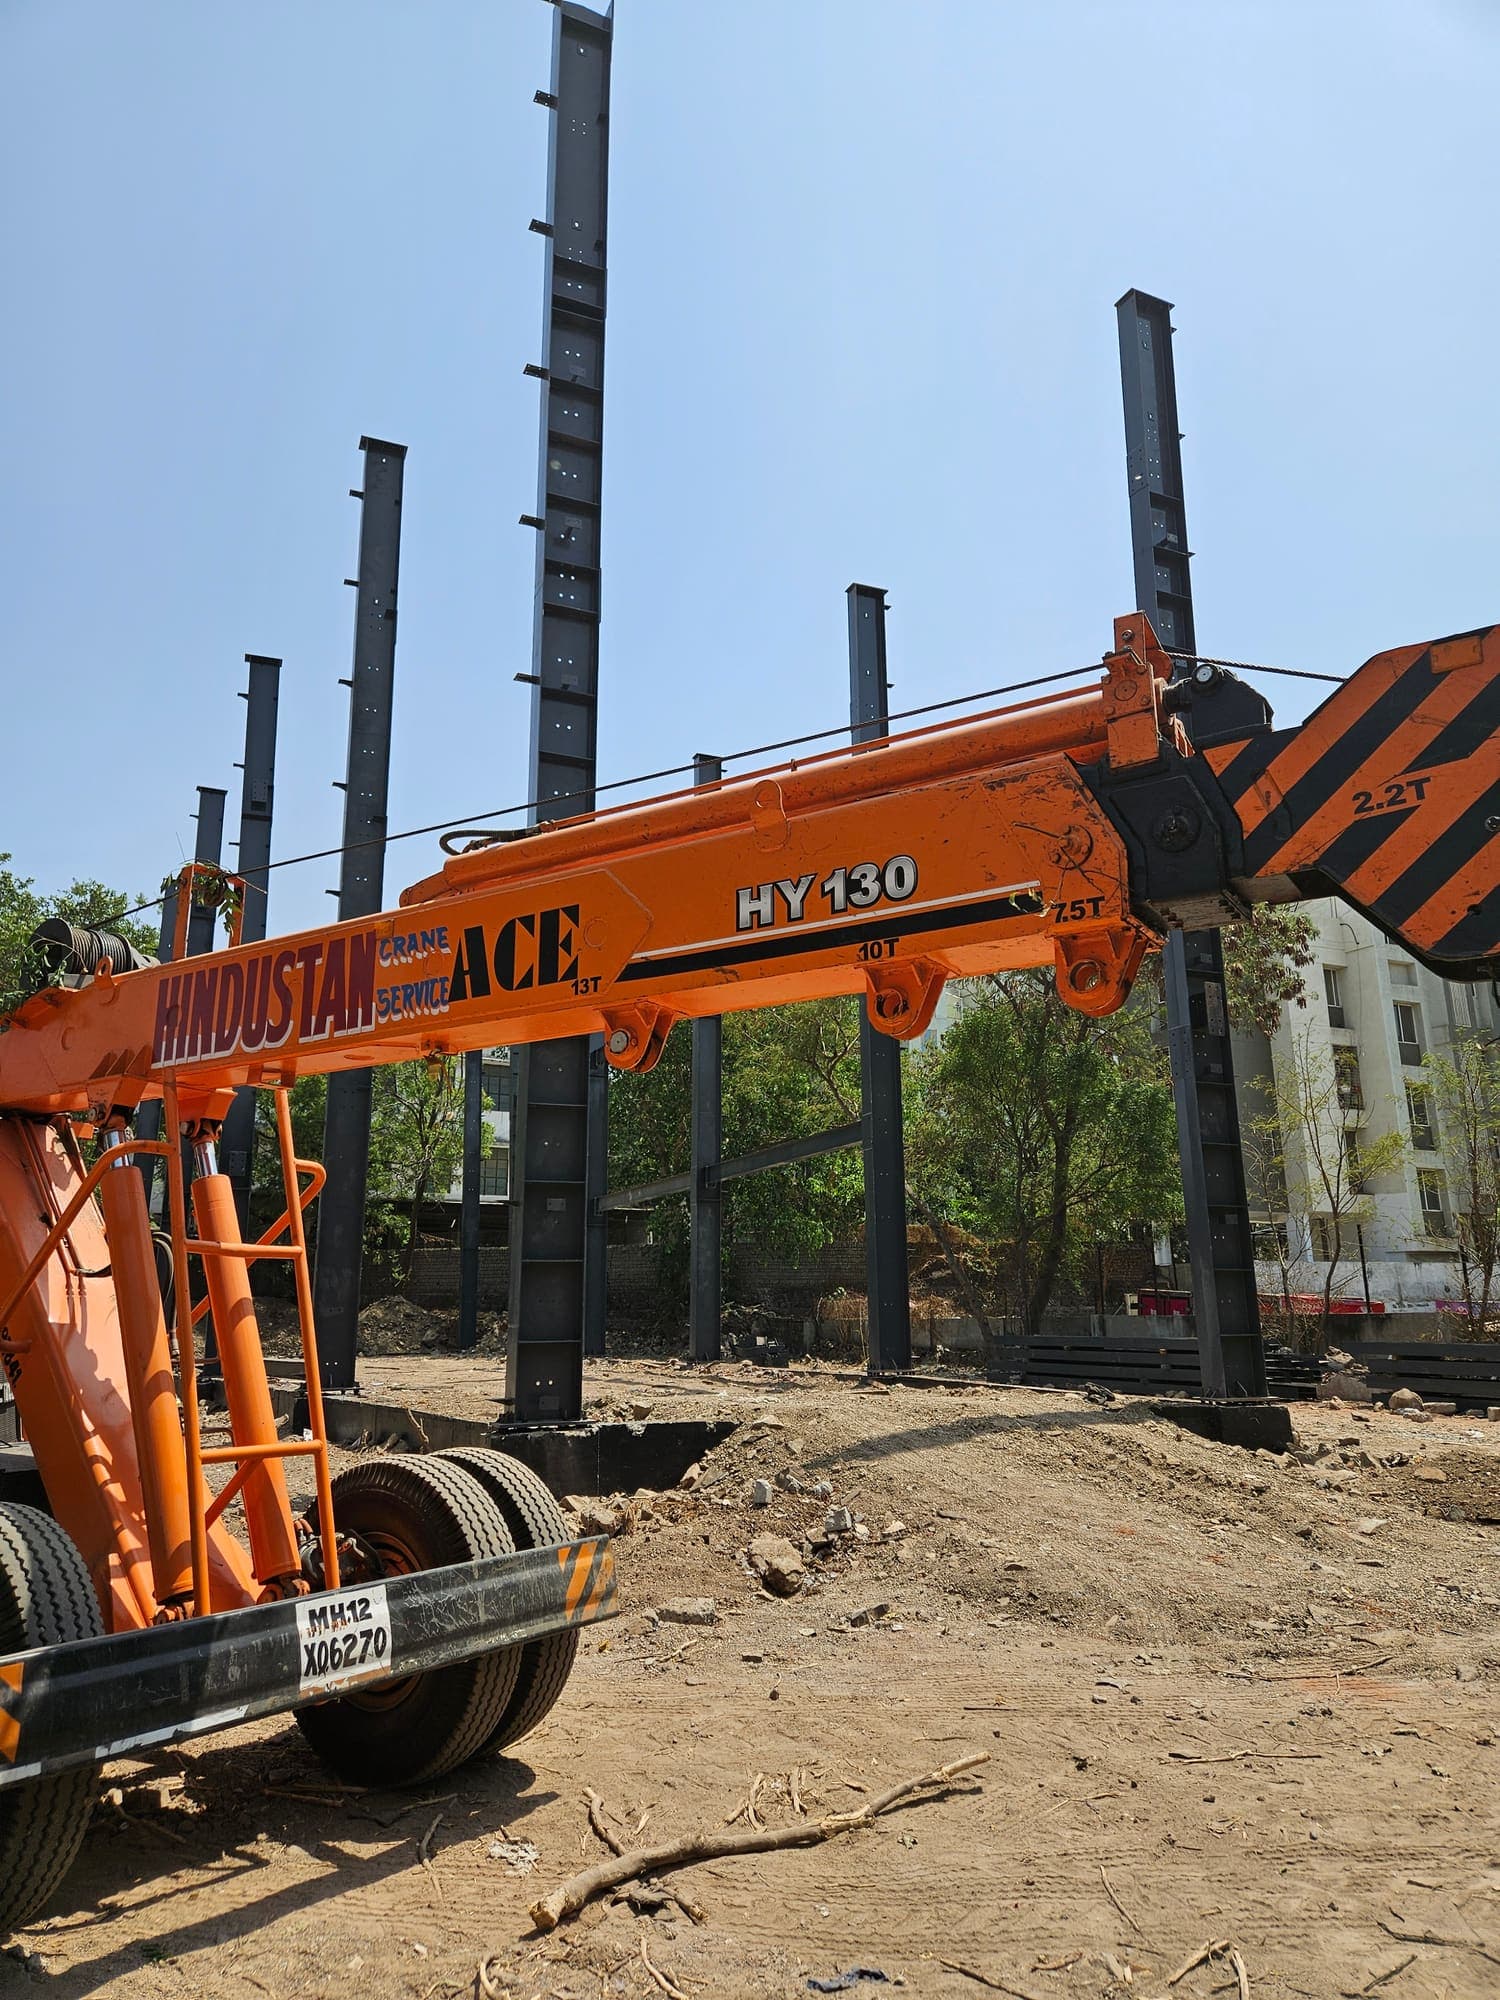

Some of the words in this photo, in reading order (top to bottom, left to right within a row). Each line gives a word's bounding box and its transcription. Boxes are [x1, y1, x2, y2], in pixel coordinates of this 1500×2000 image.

[1352, 777, 1431, 814] 2.2T
[736, 872, 818, 932] HY
[821, 855, 918, 914] 130
[1050, 896, 1105, 923] 7.5T
[379, 926, 452, 967] CRANE
[448, 904, 579, 1003] ACE
[858, 938, 900, 961] 10T
[151, 930, 376, 1069] HINDUSTAN
[376, 976, 450, 1024] SERVICE
[571, 976, 602, 996] 13T
